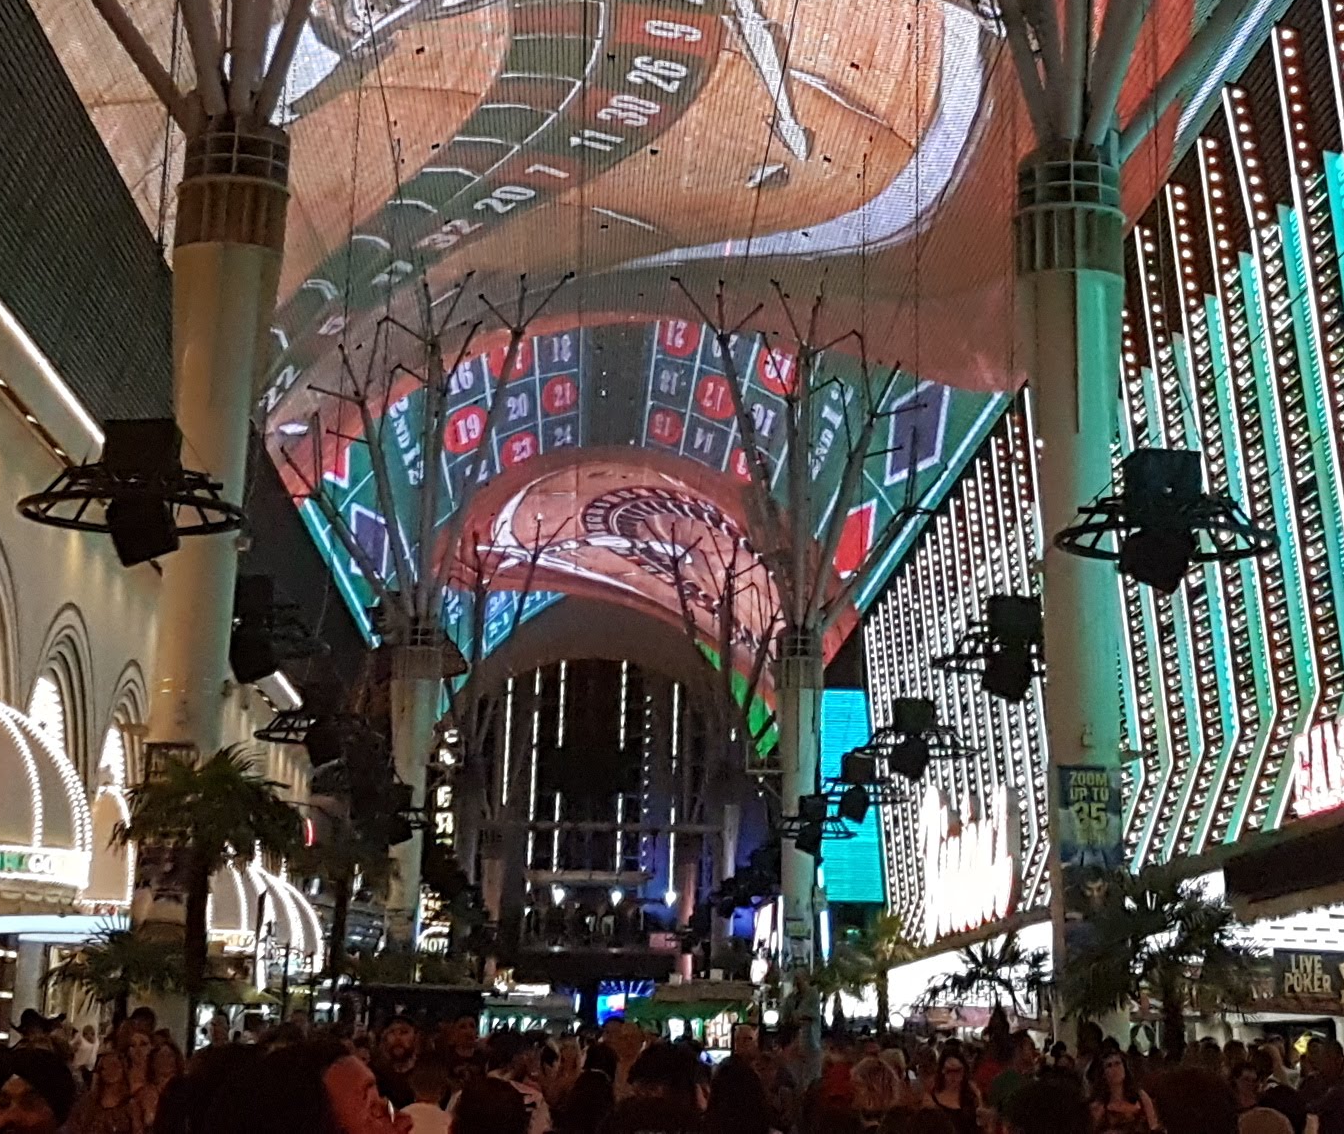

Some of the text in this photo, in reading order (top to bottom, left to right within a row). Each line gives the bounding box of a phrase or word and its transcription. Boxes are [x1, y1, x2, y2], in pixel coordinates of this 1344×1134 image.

[455, 413, 483, 447] 19
[1069, 771, 1108, 786] ZOOM
[1070, 787, 1110, 802] UP TO
[1290, 953, 1324, 974] LIVE
[1284, 972, 1332, 997] POKER
